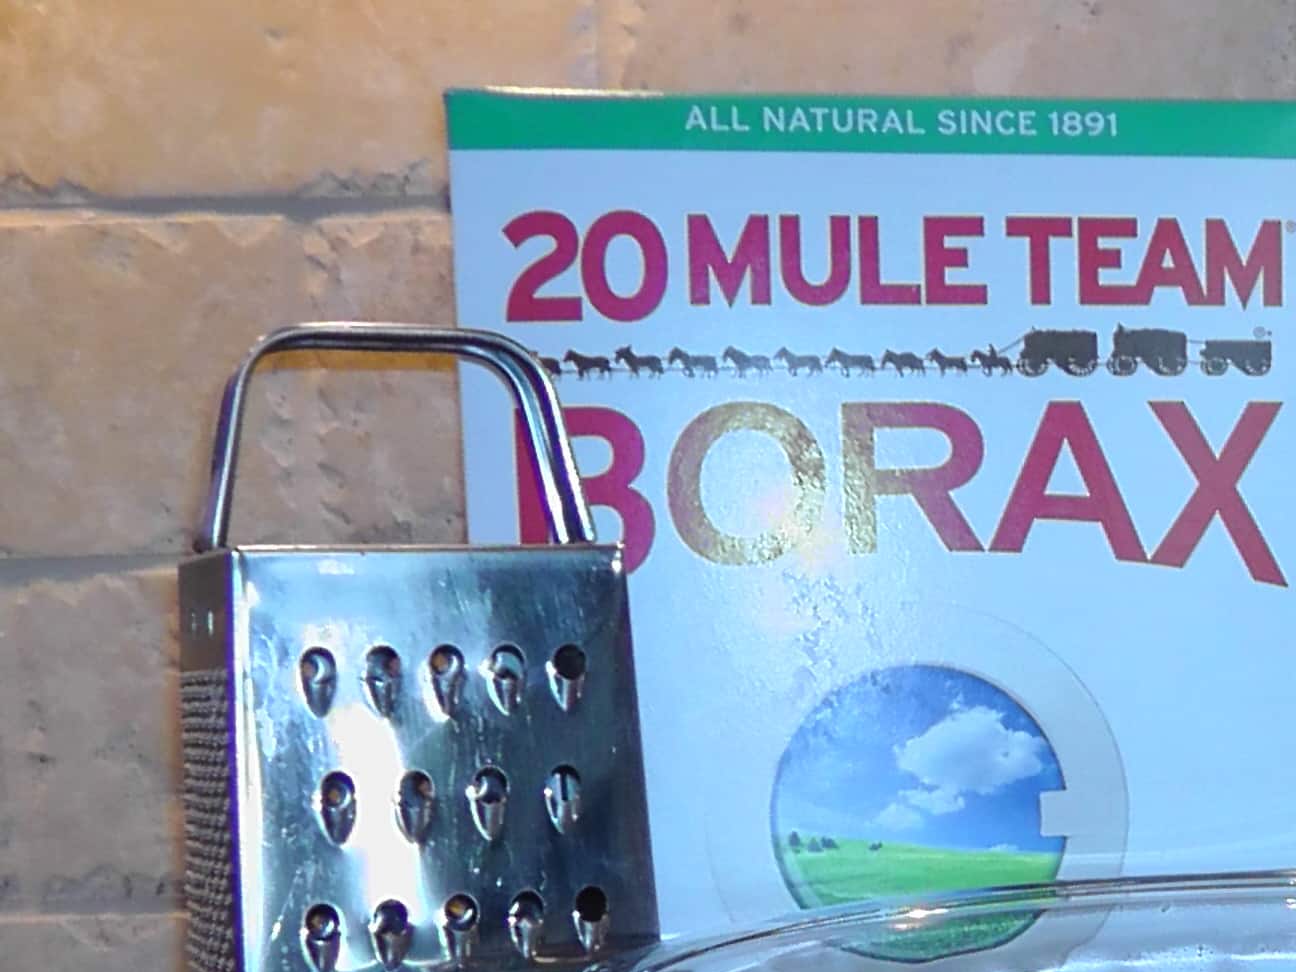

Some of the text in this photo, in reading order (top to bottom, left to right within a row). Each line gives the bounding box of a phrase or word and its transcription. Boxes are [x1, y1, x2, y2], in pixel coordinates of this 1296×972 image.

[684, 105, 1119, 138] ALL NATURAL SINCE 1891
[501, 209, 1283, 323] 20 MULE TEAM
[514, 400, 1289, 588] BORAX
